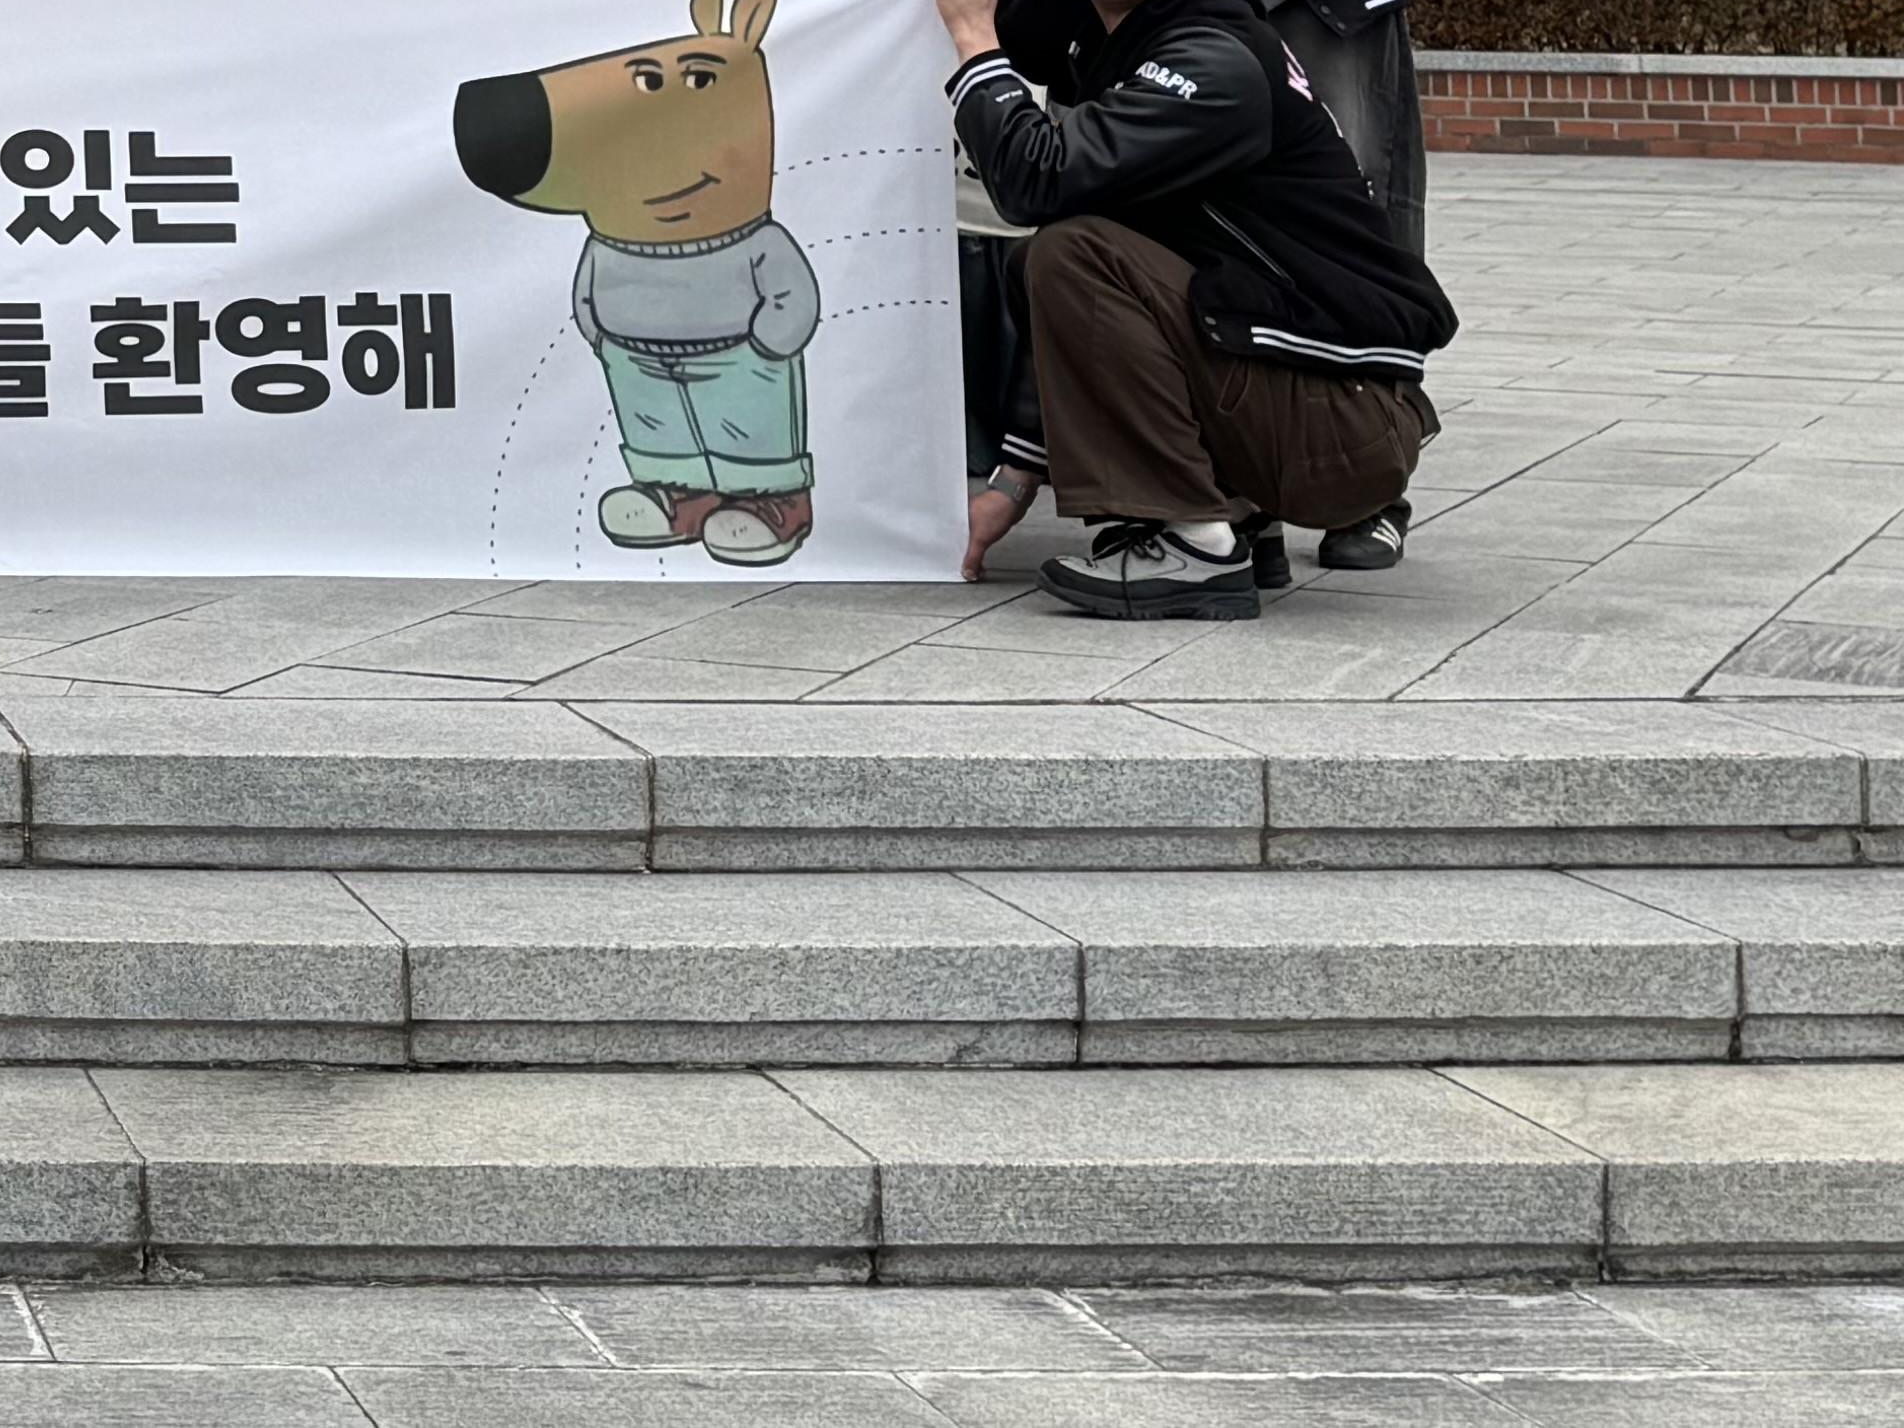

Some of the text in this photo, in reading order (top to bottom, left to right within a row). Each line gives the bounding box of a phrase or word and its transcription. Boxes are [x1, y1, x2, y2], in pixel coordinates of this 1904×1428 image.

[1135, 61, 1198, 101] AD&PR
[0, 128, 240, 246] 있는
[90, 292, 458, 415] 환영해
